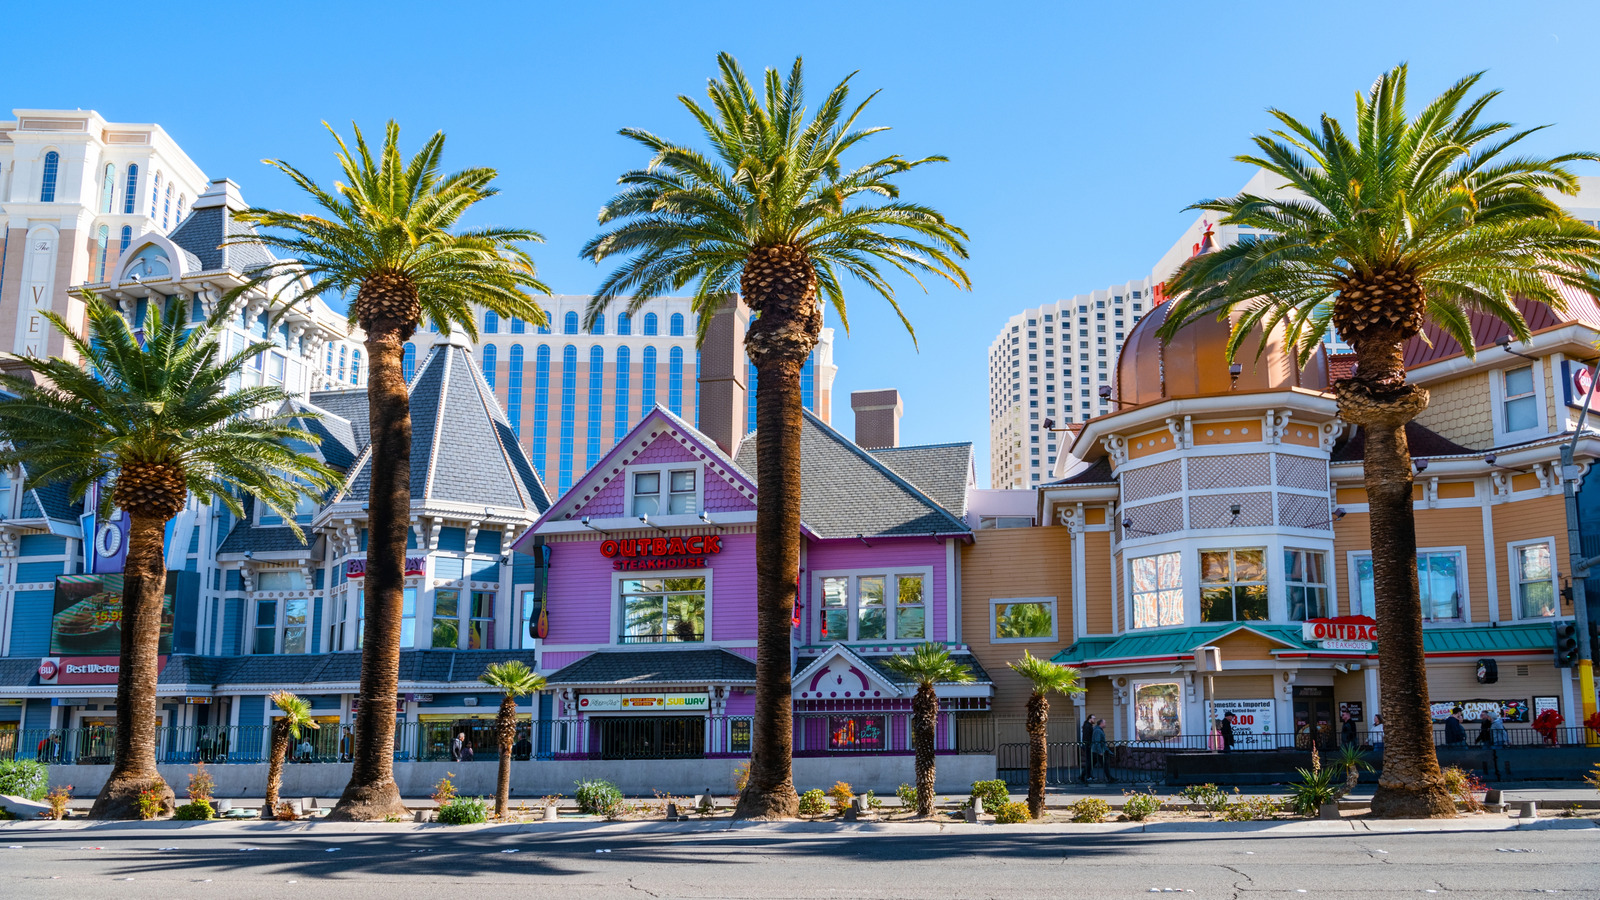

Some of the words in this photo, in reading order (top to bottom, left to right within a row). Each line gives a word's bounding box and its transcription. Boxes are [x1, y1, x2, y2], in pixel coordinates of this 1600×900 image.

[34, 241, 50, 252] The
[26, 286, 44, 358] VEN
[600, 536, 721, 558] OUTBACK
[612, 557, 706, 571] STEAKHOUSE
[1314, 623, 1377, 641] OUTBAC
[1326, 641, 1369, 650] STEAKHOUSE
[66, 664, 87, 673] Best
[666, 697, 706, 706] SUBWAY
[1464, 702, 1499, 712] CASINO
